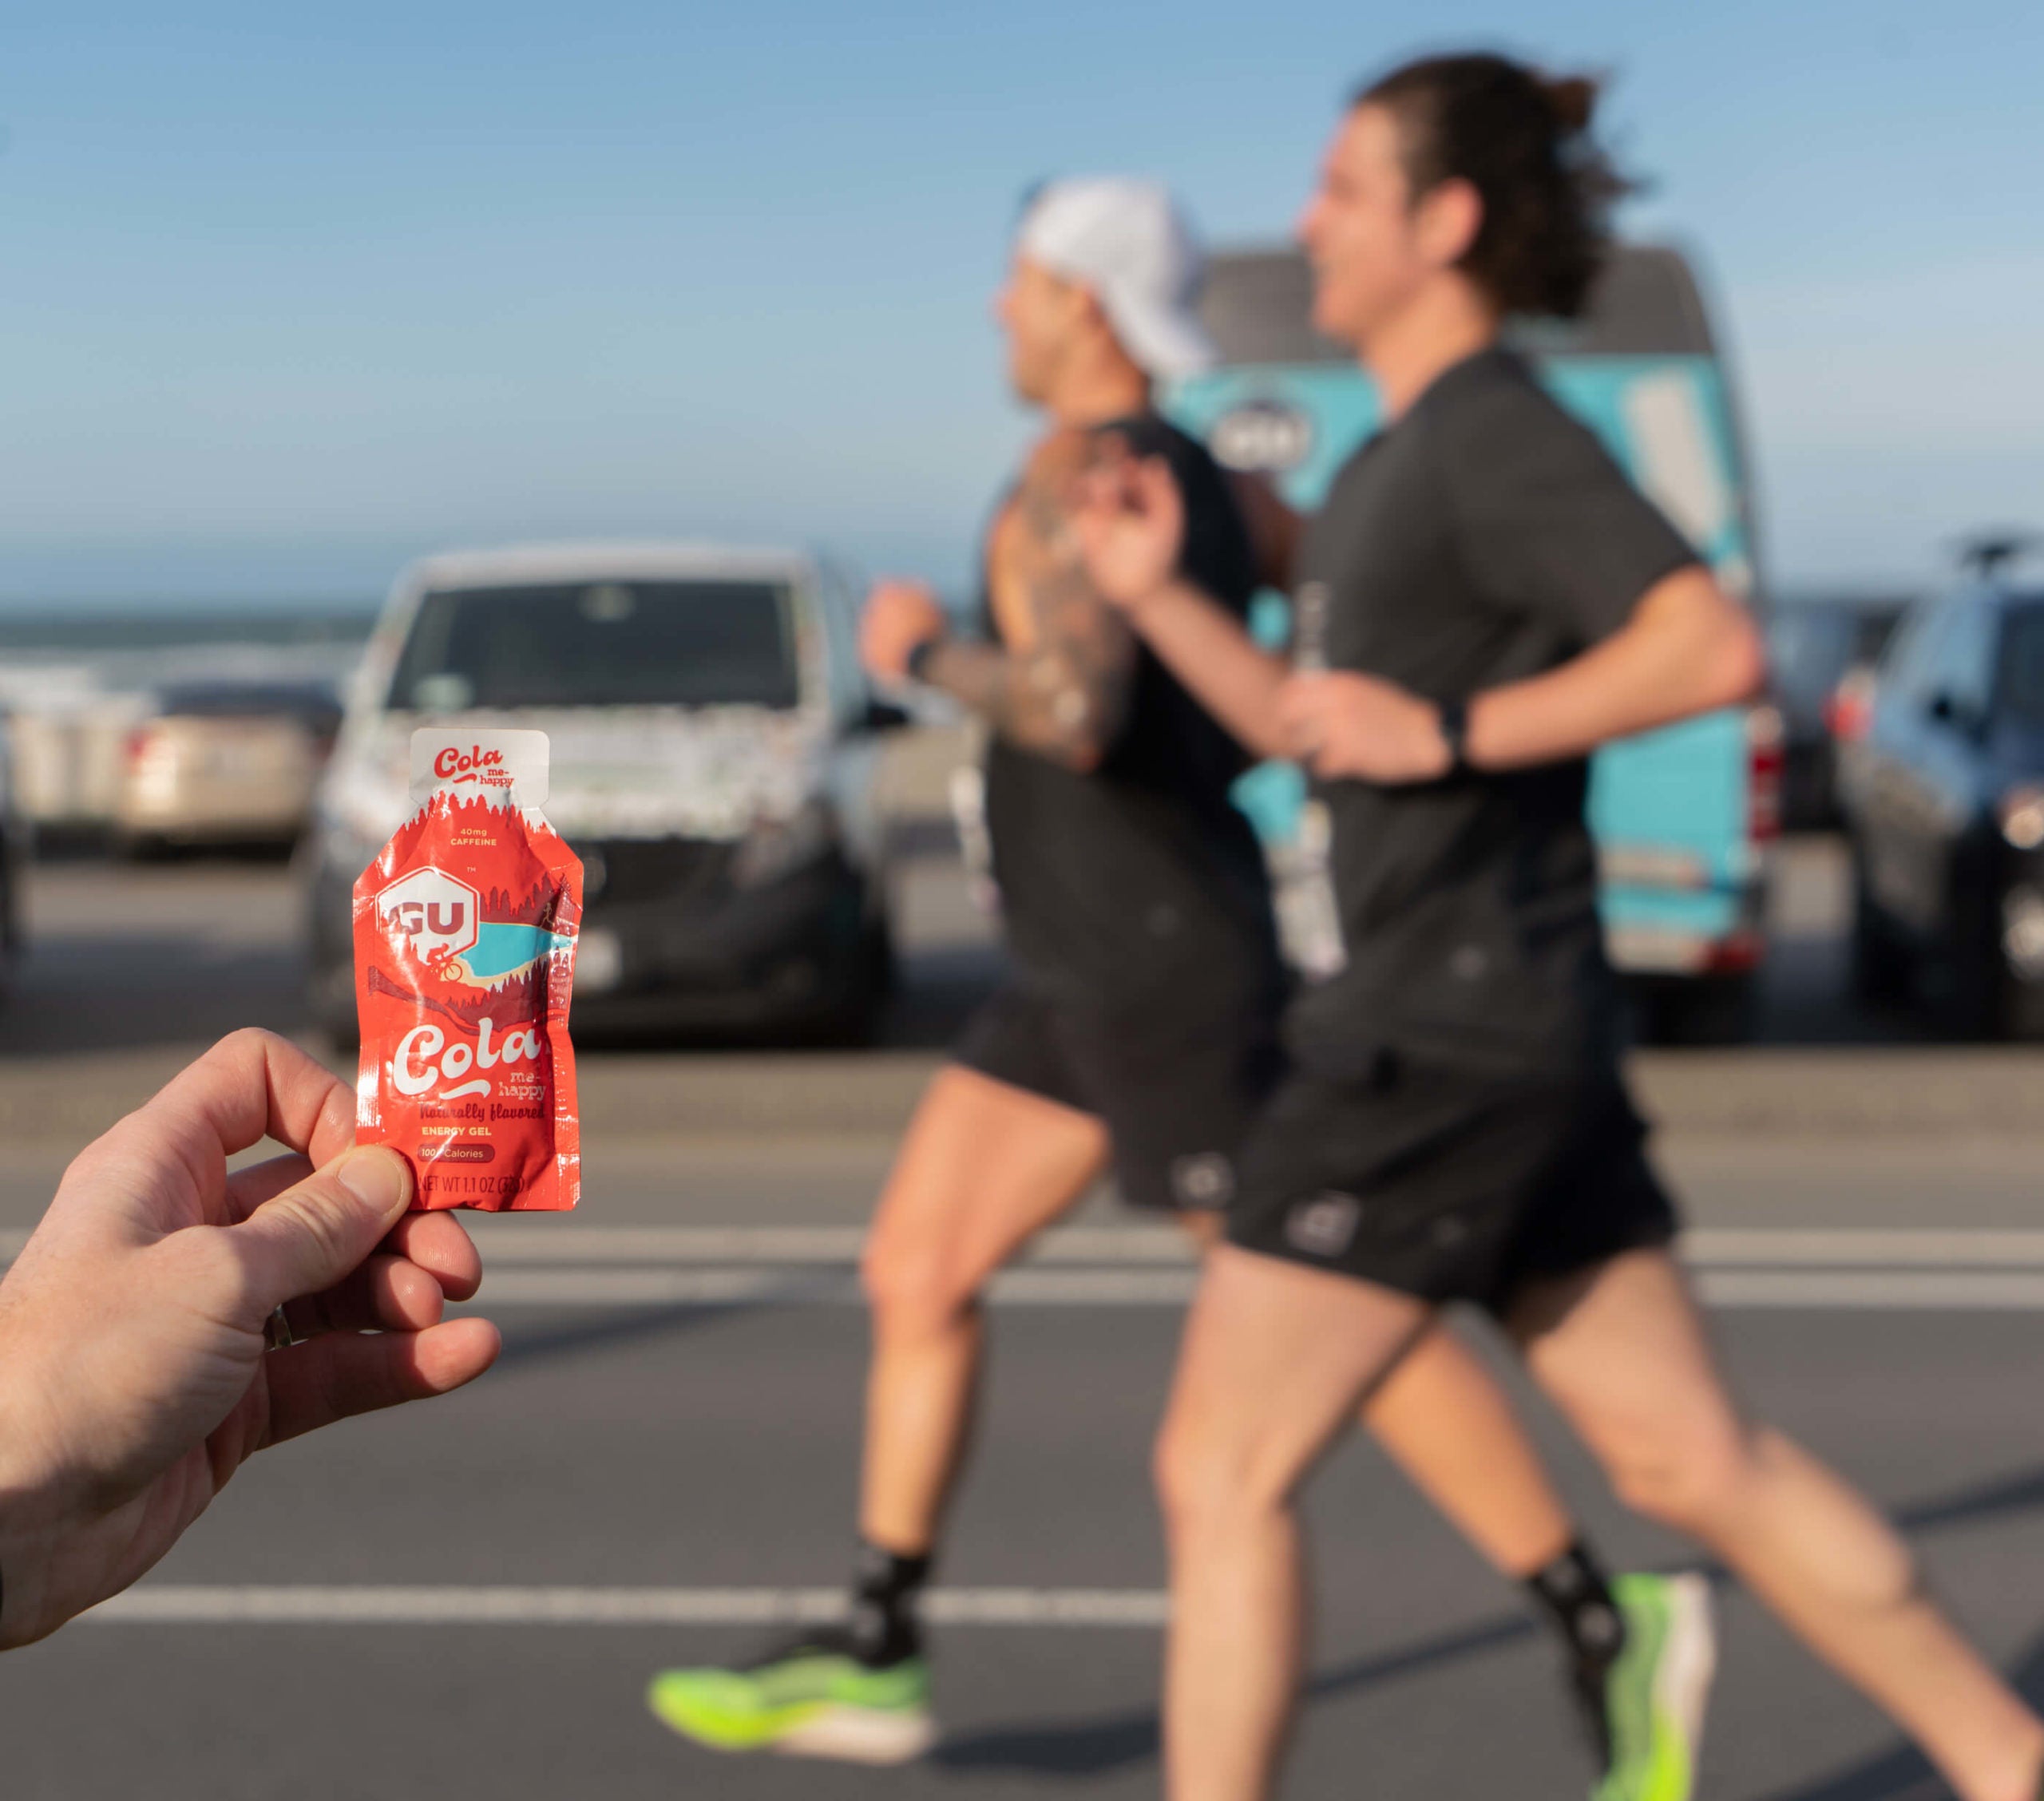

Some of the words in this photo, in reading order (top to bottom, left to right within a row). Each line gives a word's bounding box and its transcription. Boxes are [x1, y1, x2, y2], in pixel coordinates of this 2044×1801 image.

[434, 745, 503, 778] Cola
[480, 775, 514, 788] happy
[461, 828, 487, 837] 40mg
[389, 902, 464, 935] GU
[393, 1017, 541, 1095] Cola
[498, 1082, 546, 1100] happy
[490, 1103, 545, 1122] flavored
[422, 1127, 465, 1136] ENERGY
[469, 1127, 492, 1136] GEL
[422, 1148, 437, 1157] 100
[444, 1149, 484, 1158] Calories
[442, 1177, 461, 1192] WT
[463, 1177, 476, 1193] 1.1
[480, 1177, 494, 1193] OZ
